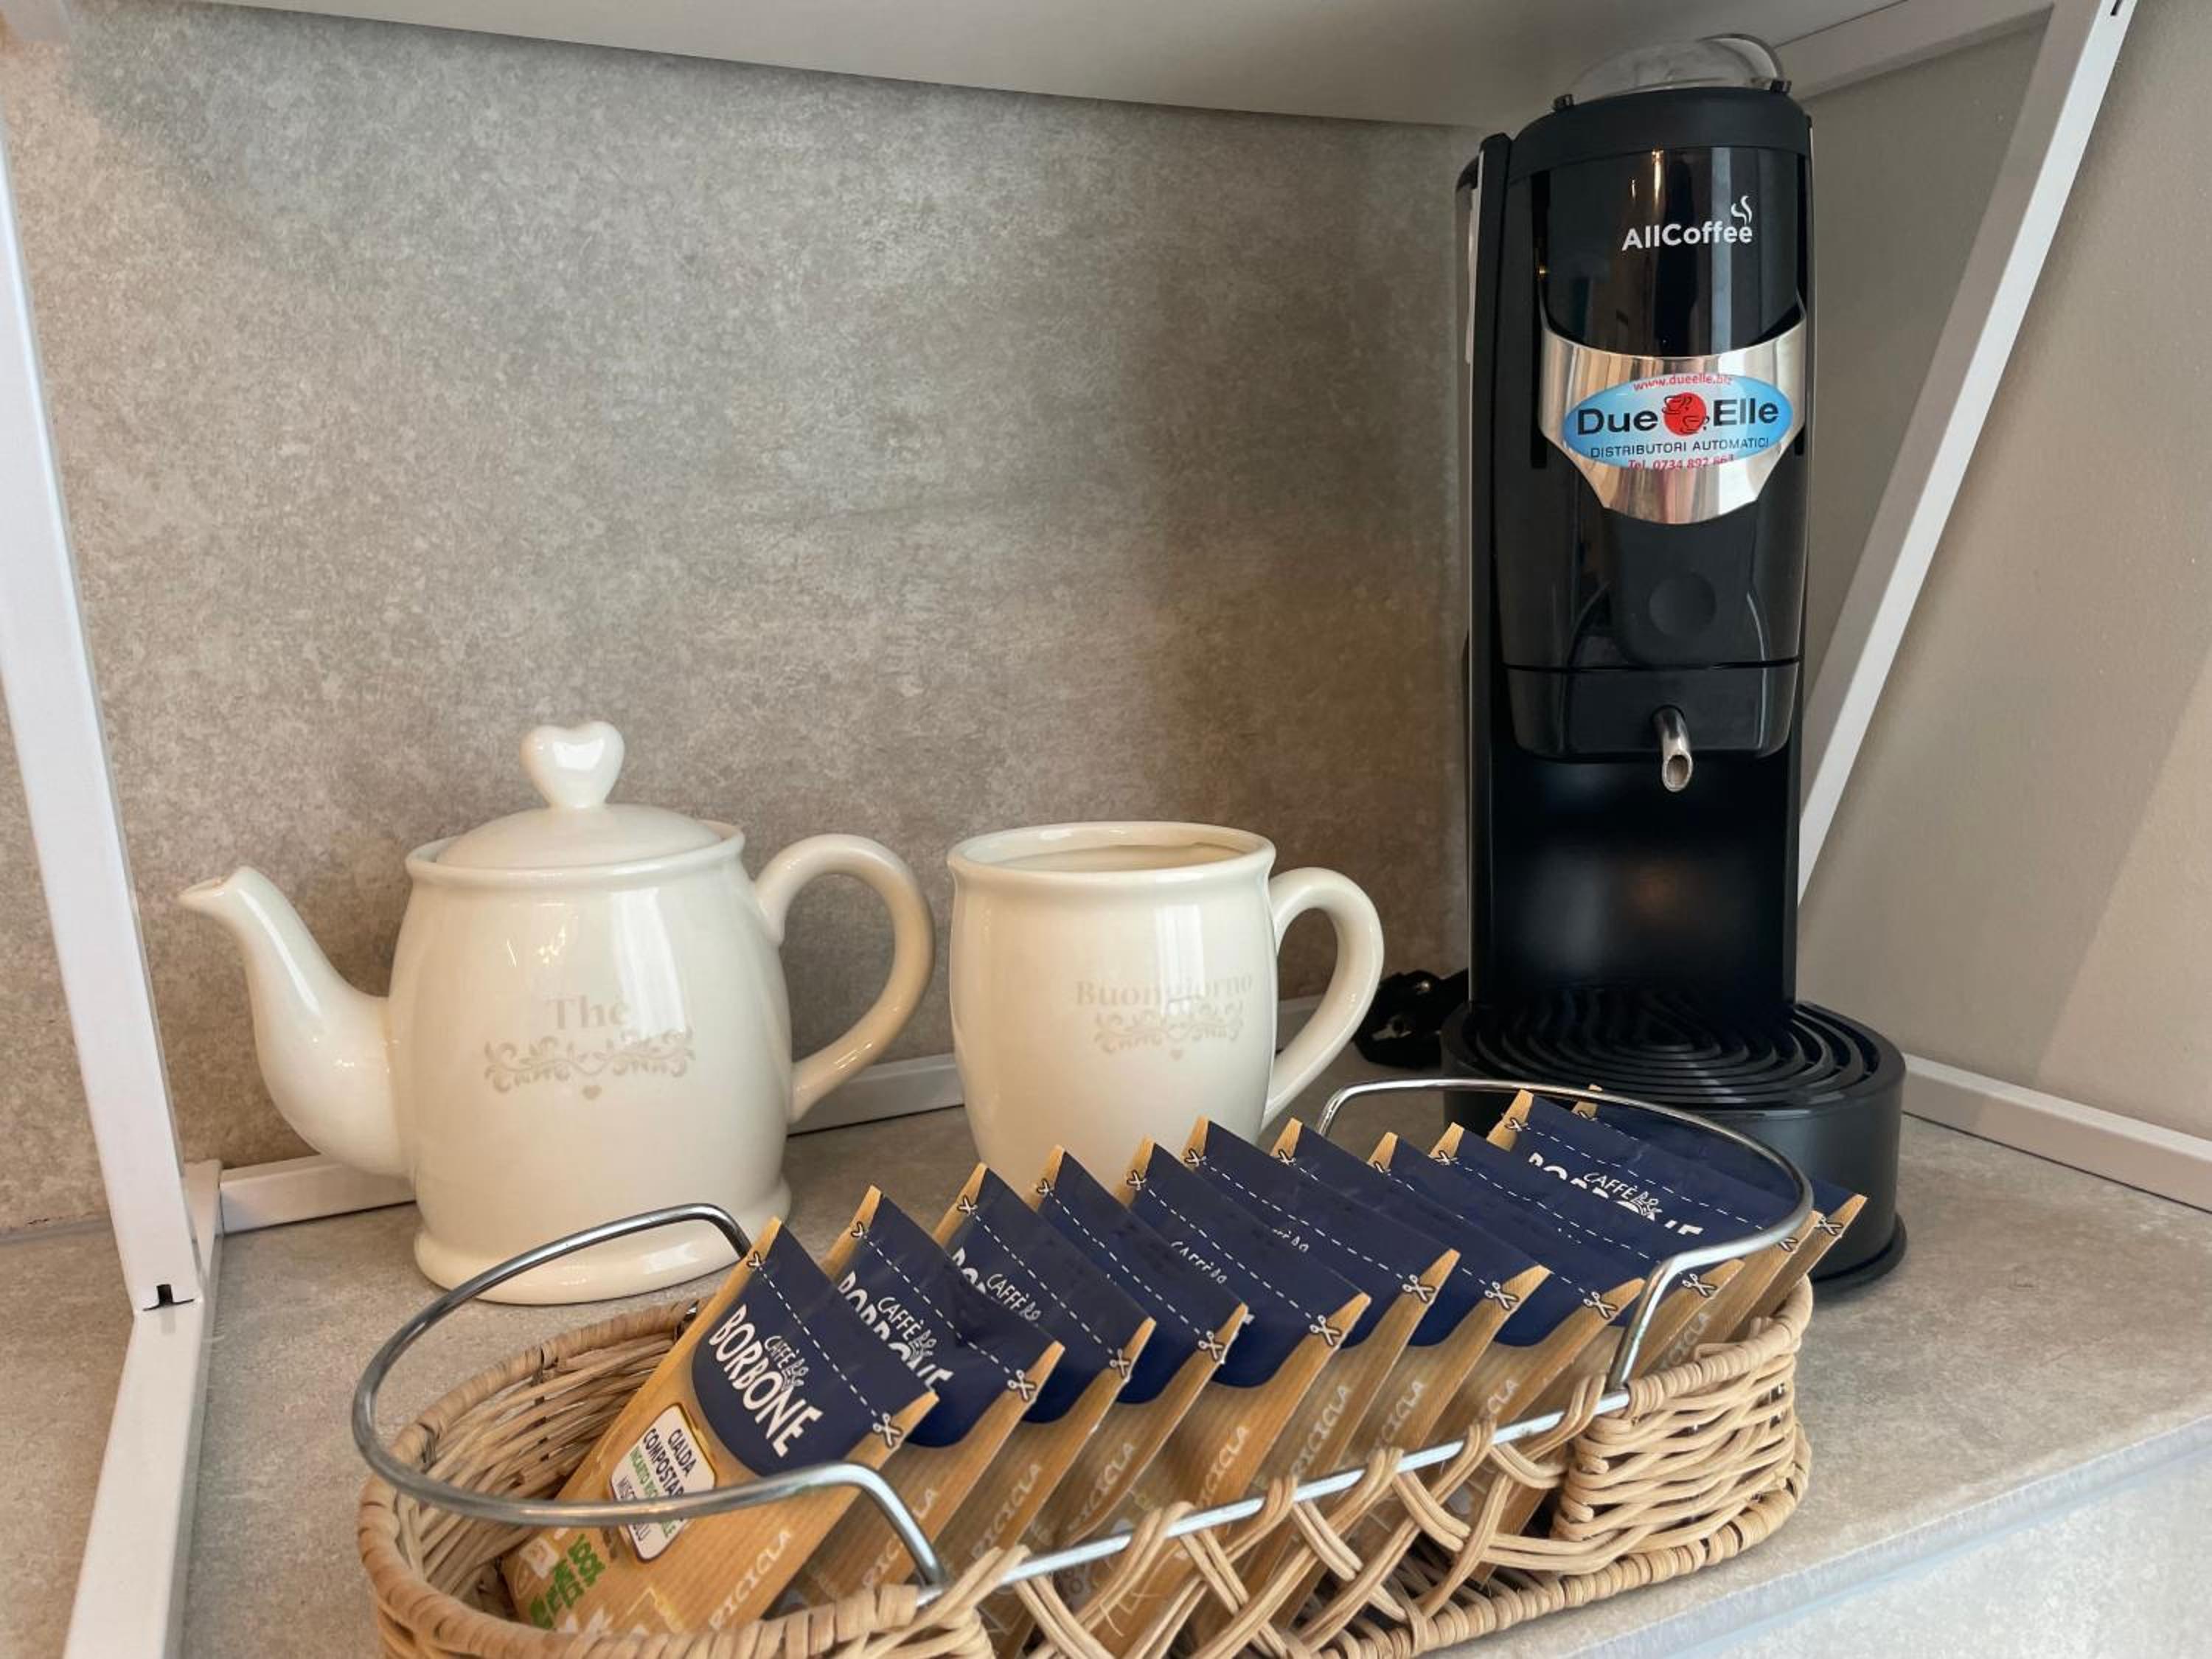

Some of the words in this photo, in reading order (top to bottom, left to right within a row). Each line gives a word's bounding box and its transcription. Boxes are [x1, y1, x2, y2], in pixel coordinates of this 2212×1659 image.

[1621, 220, 1753, 251] AllCoffee
[1577, 408, 1659, 436] Due
[1713, 397, 1779, 427] Elle
[1590, 442, 1687, 459] DISTRIBUTORI
[1692, 437, 1770, 451] AUTOMATICI
[709, 1304, 824, 1458] BORBONE
[667, 1428, 697, 1477] CIALDA
